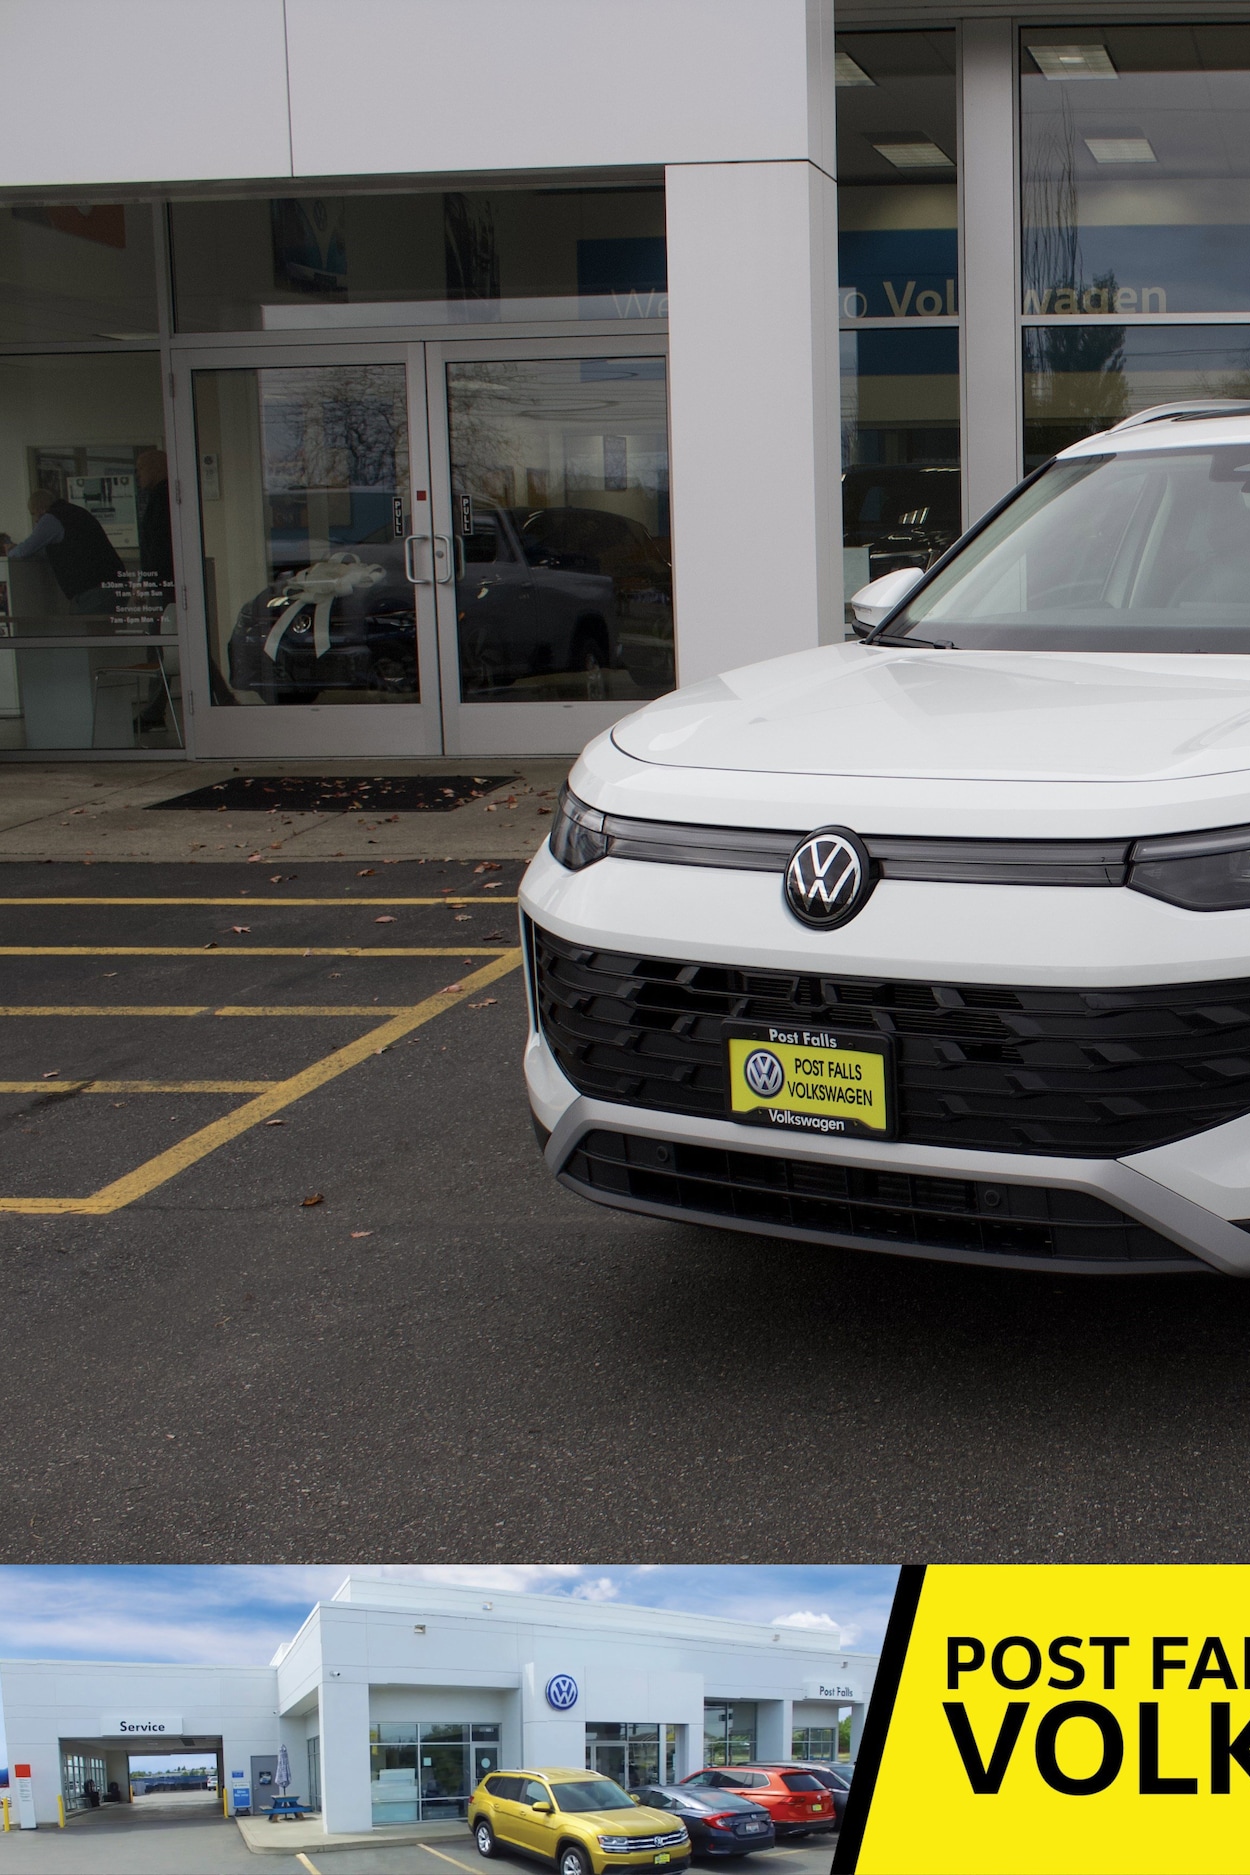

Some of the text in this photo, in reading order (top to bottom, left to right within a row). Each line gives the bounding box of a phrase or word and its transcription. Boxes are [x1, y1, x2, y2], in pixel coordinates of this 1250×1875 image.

[394, 500, 402, 534] PULL
[463, 498, 471, 532] PULL
[117, 570, 136, 578] Sales
[769, 1028, 837, 1048] Post Falls
[795, 1058, 862, 1081] POST FALLS
[787, 1081, 872, 1106] VOLKSWAGEN
[768, 1109, 845, 1132] Volkswagen
